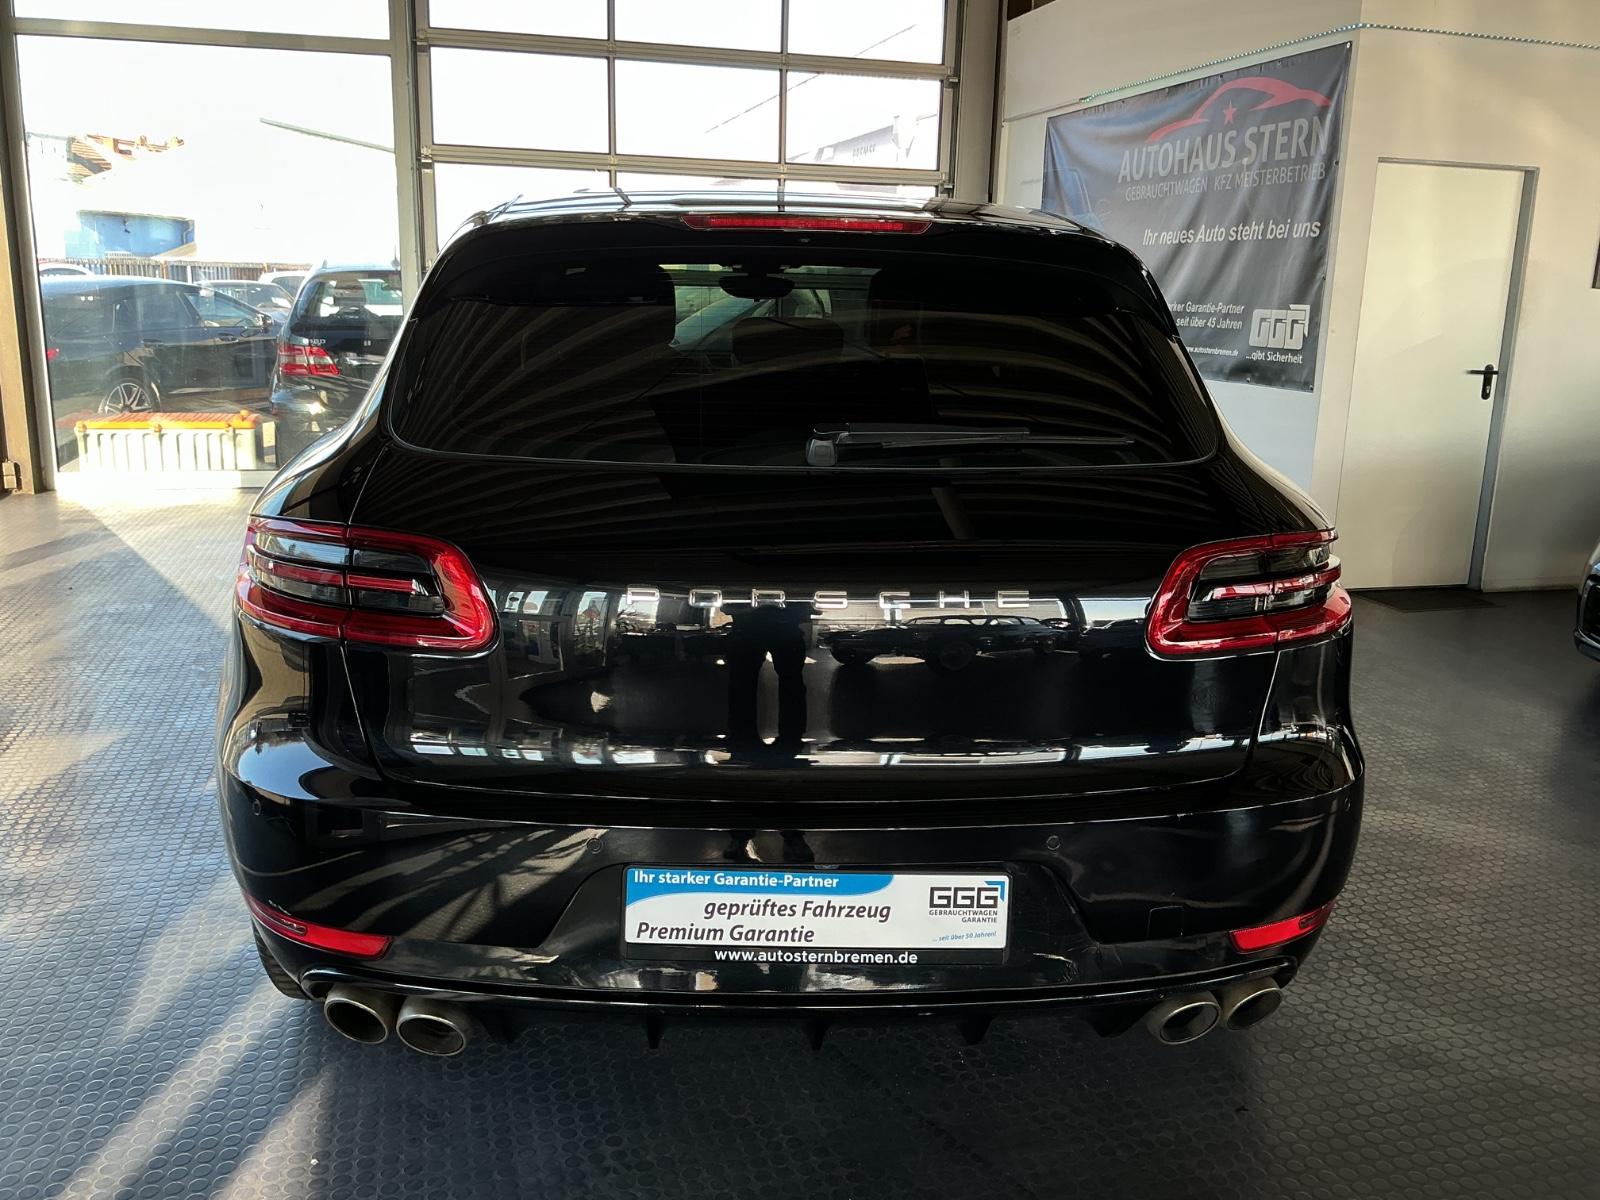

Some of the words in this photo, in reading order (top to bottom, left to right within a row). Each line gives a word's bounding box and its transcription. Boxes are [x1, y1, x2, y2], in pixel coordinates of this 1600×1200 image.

[1118, 130, 1237, 183] AUTOHAUS
[1242, 115, 1330, 166] STERN
[1125, 177, 1208, 202] GEBRAUCHTWAGEN
[1214, 175, 1232, 191] KFZ
[1235, 162, 1326, 188] MEISTERBETRIEB
[1142, 229, 1158, 245] Ihr
[1159, 229, 1194, 244] neues
[1196, 223, 1226, 243] Auto
[1228, 222, 1264, 241] steht
[1266, 219, 1291, 240] bei
[1293, 221, 1321, 239] uns
[1186, 301, 1245, 314] Garantie-Partner
[1176, 316, 1190, 327] seit
[1190, 316, 1206, 328] über
[1207, 317, 1216, 328] 45
[1217, 318, 1243, 330] Jahren
[1267, 351, 1303, 364] Sicherheit
[627, 588, 1030, 609] PORSCHE
[634, 870, 656, 884] Ihr
[658, 871, 710, 885] starker
[713, 873, 839, 888] Garantie-Partner
[929, 887, 999, 909] GGG
[704, 898, 797, 921] geprüftes
[801, 901, 891, 922] Fahrzeug
[636, 922, 724, 941] Premium
[729, 924, 815, 943] Garantie
[714, 949, 918, 964] www.autosternbremen.de
